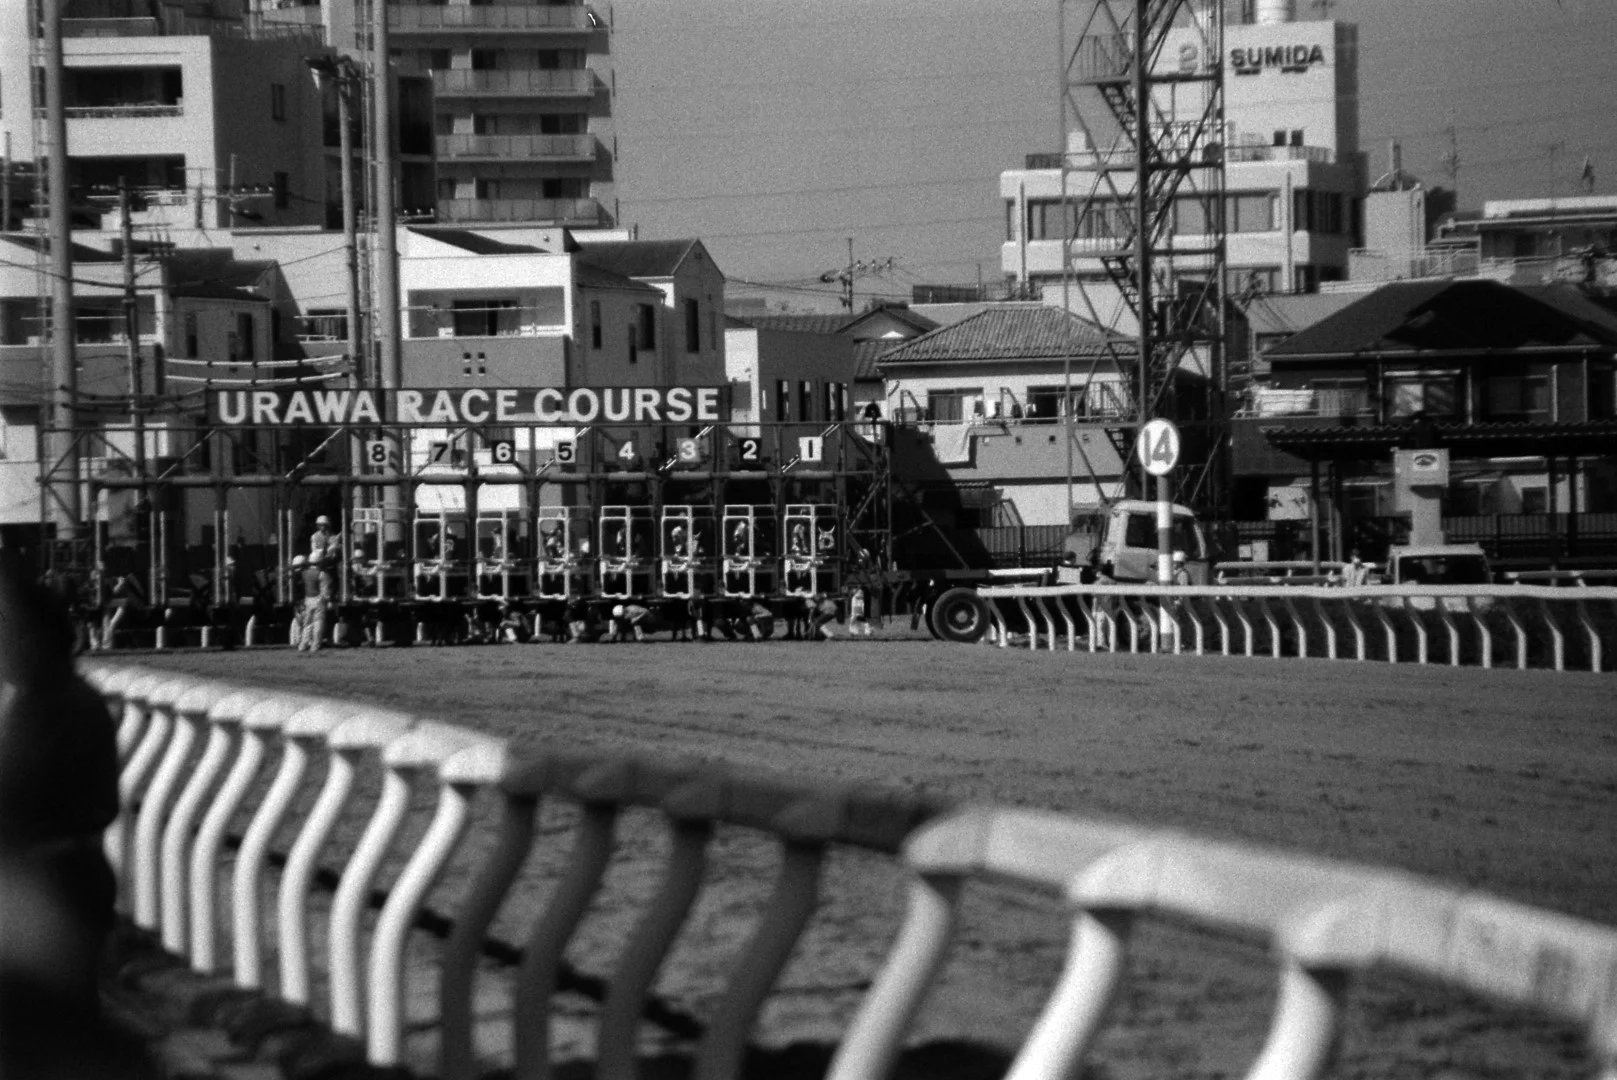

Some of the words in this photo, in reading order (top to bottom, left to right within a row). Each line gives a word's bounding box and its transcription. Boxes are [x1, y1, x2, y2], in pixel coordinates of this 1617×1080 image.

[1230, 44, 1325, 67] SUMIDA
[218, 390, 380, 424] URAWA
[397, 389, 519, 423] RACE
[533, 388, 719, 422] COURSE
[371, 443, 387, 463] 8
[432, 442, 449, 462] 7
[495, 442, 512, 462] 6
[557, 441, 573, 461] 5
[618, 441, 635, 460] 4
[680, 440, 697, 459] 3
[742, 440, 758, 459] 2
[1144, 427, 1174, 466] 14
